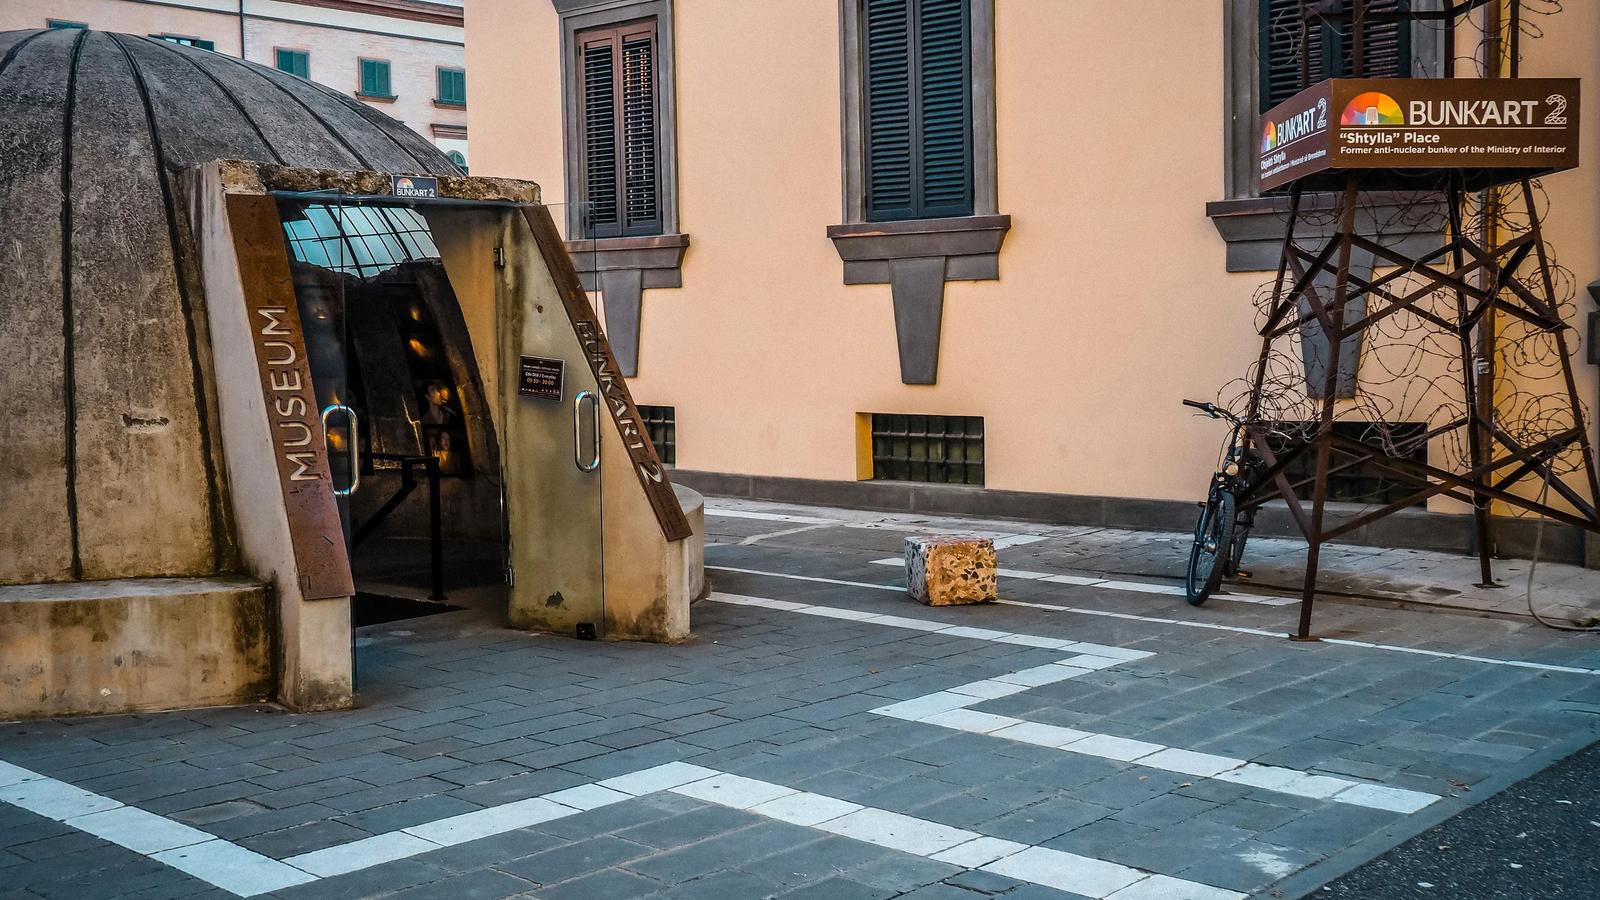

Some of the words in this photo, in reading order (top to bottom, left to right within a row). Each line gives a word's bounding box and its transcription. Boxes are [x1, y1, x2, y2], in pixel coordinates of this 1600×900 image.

[1317, 97, 1327, 129] 2
[1409, 100, 1539, 125] BUNK'ART
[1544, 93, 1567, 125] 2
[1340, 132, 1400, 146] “Shtylla”
[1404, 132, 1441, 144] Place
[1340, 146, 1373, 154] Former
[1374, 145, 1426, 154] anti-nuclear
[1427, 145, 1458, 154] bunker
[1459, 145, 1469, 153] of
[1470, 145, 1486, 153] the
[1486, 145, 1521, 155] Ministry
[1522, 145, 1533, 153] of
[1534, 145, 1567, 153] Interior
[428, 188, 435, 197] 2
[257, 305, 323, 482] MUSEUM
[638, 461, 664, 486] 2
